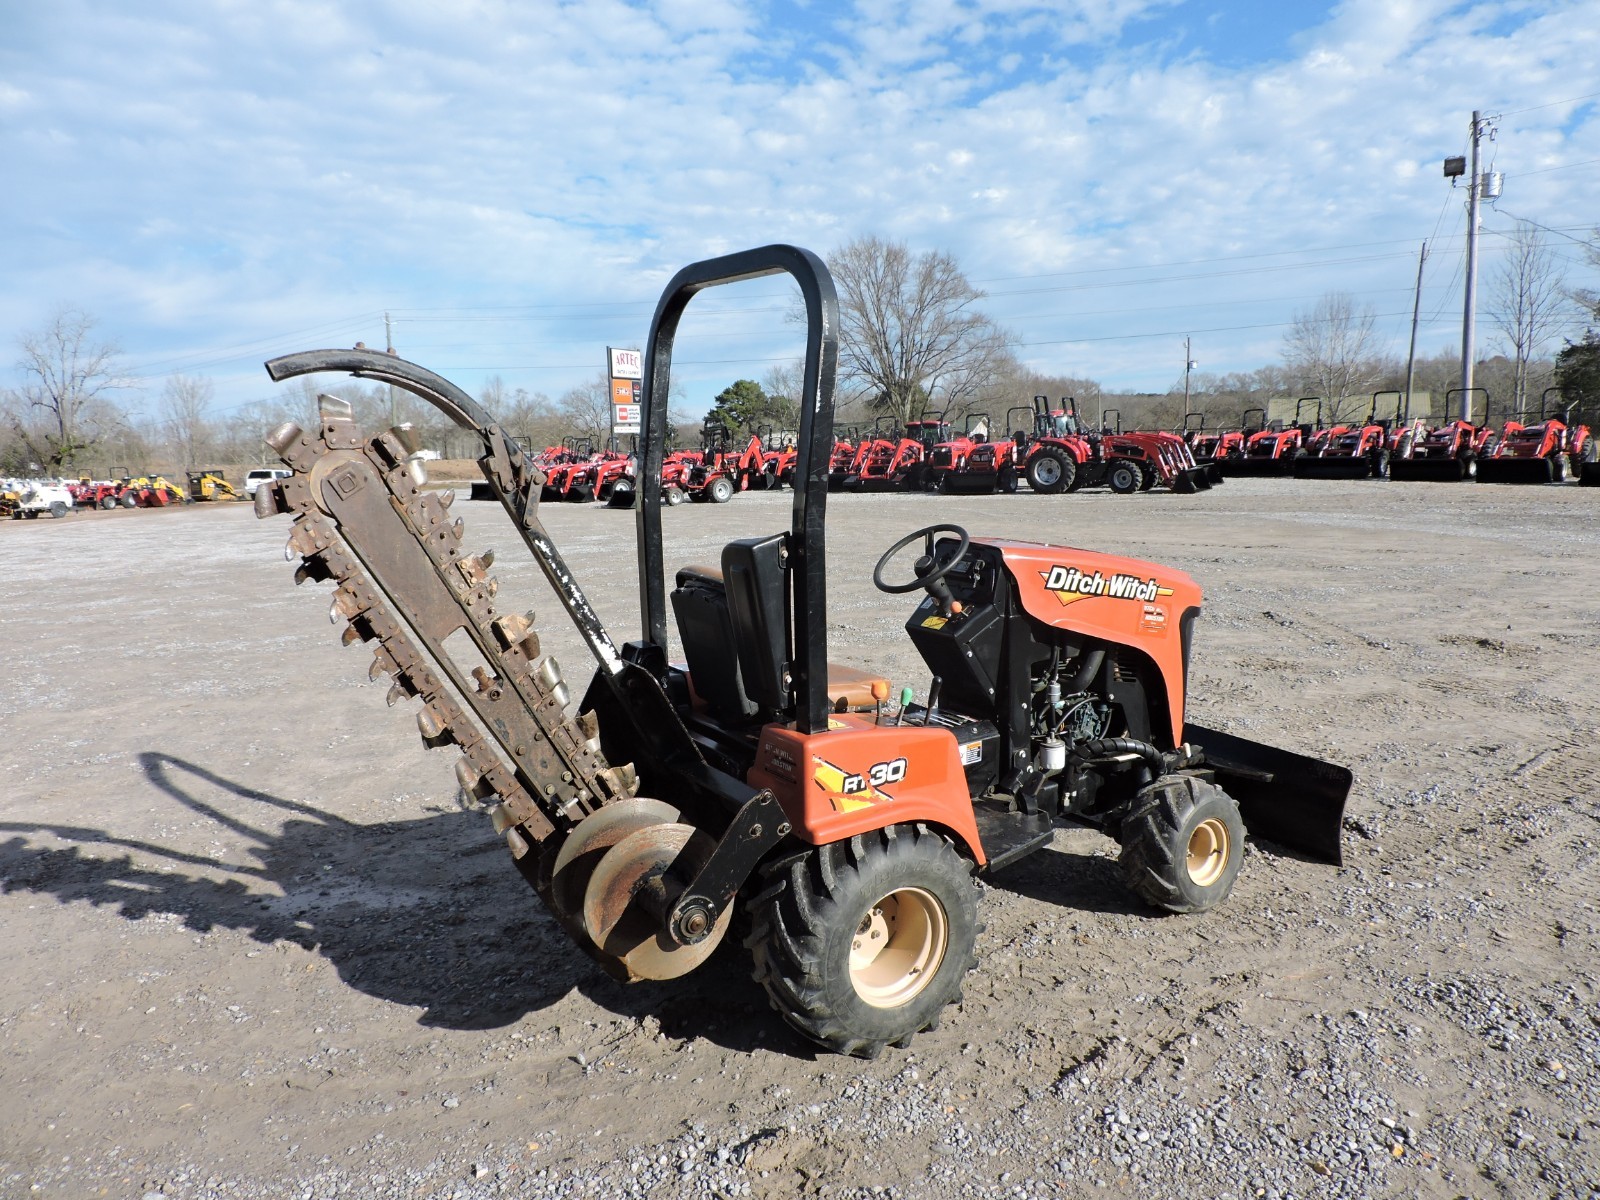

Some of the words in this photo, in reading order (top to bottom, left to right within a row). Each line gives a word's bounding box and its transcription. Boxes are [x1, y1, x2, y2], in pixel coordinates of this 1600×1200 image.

[616, 353, 639, 369] ARTEC
[1046, 566, 1103, 595] Ditch
[1109, 574, 1158, 601] Witch
